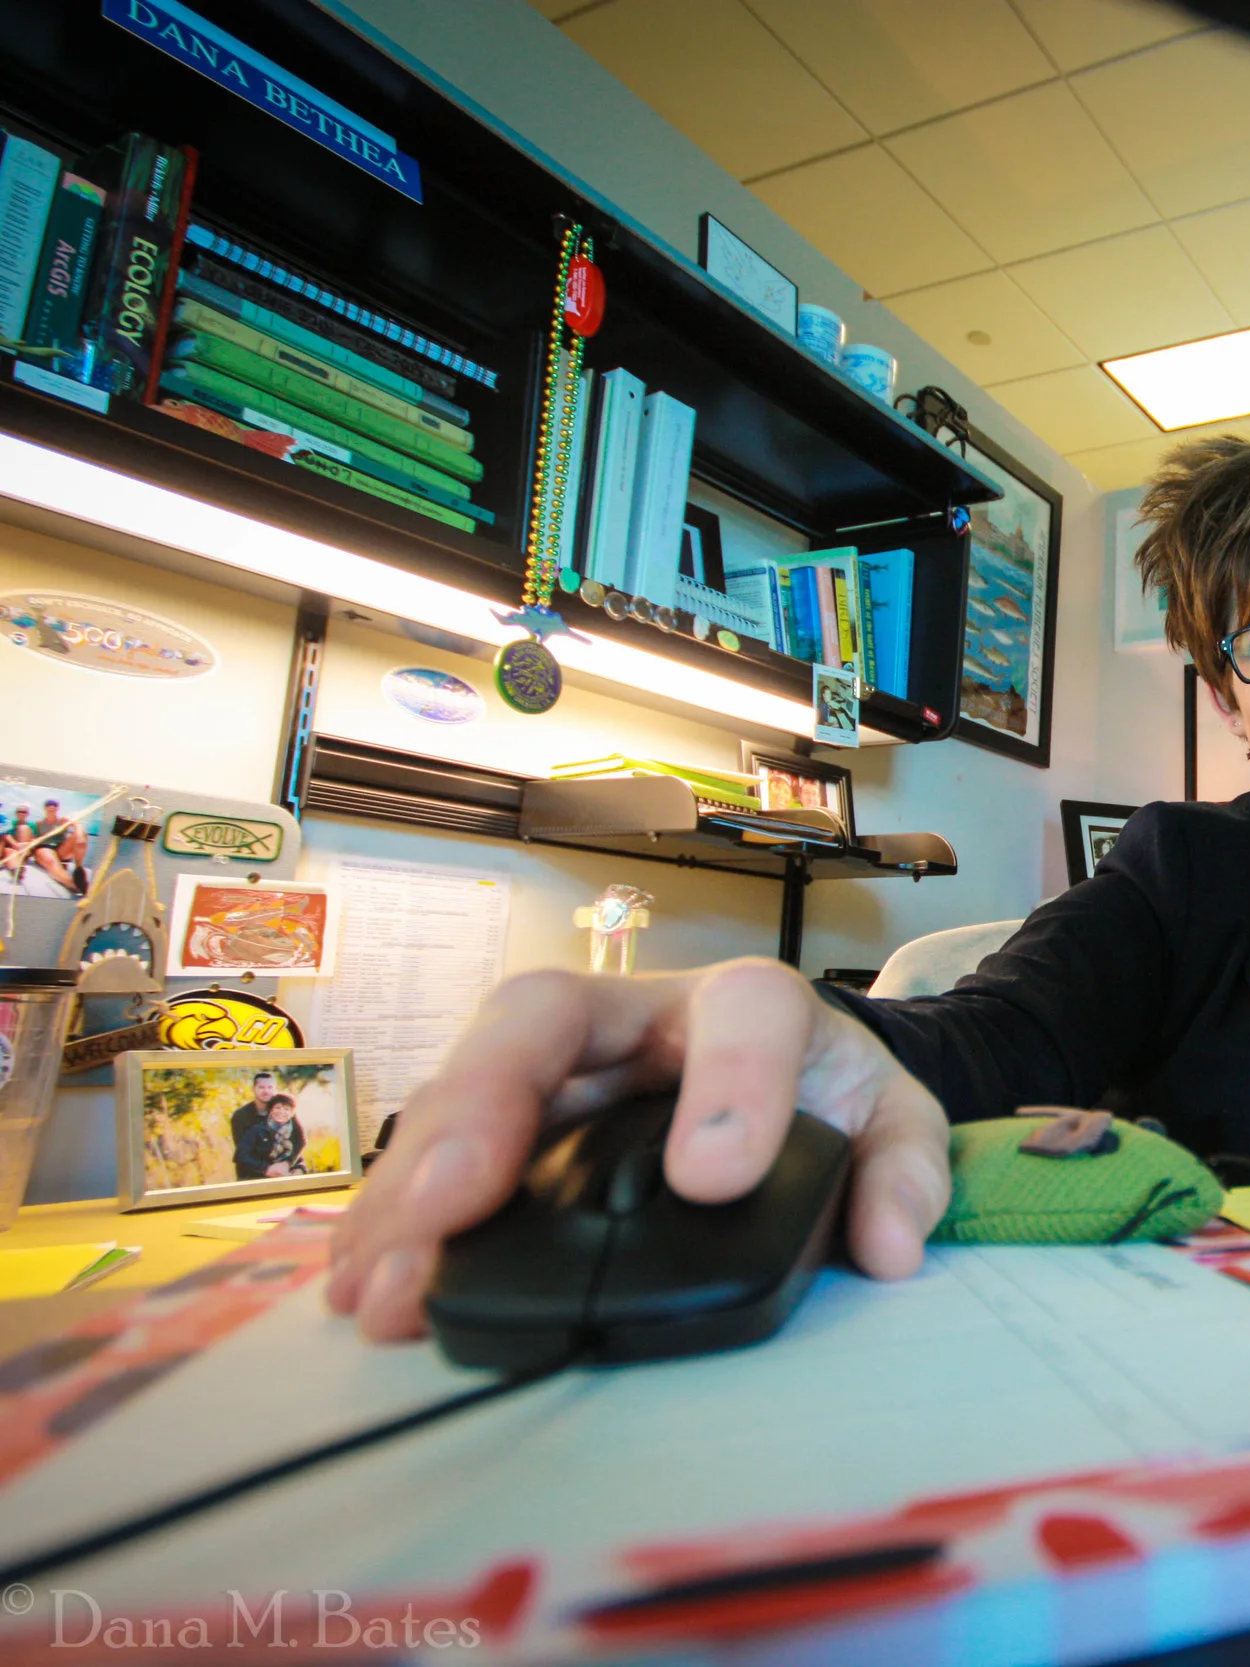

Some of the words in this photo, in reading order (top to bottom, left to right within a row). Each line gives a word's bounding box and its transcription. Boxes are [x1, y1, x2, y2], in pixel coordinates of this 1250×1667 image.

[128, 0, 250, 88] DANA
[263, 79, 408, 184] BETHEA
[48, 239, 77, 298] ArcGIS
[116, 236, 159, 348] ECOLOGY
[192, 825, 250, 845] EVOLVE
[235, 1016, 287, 1043] GO
